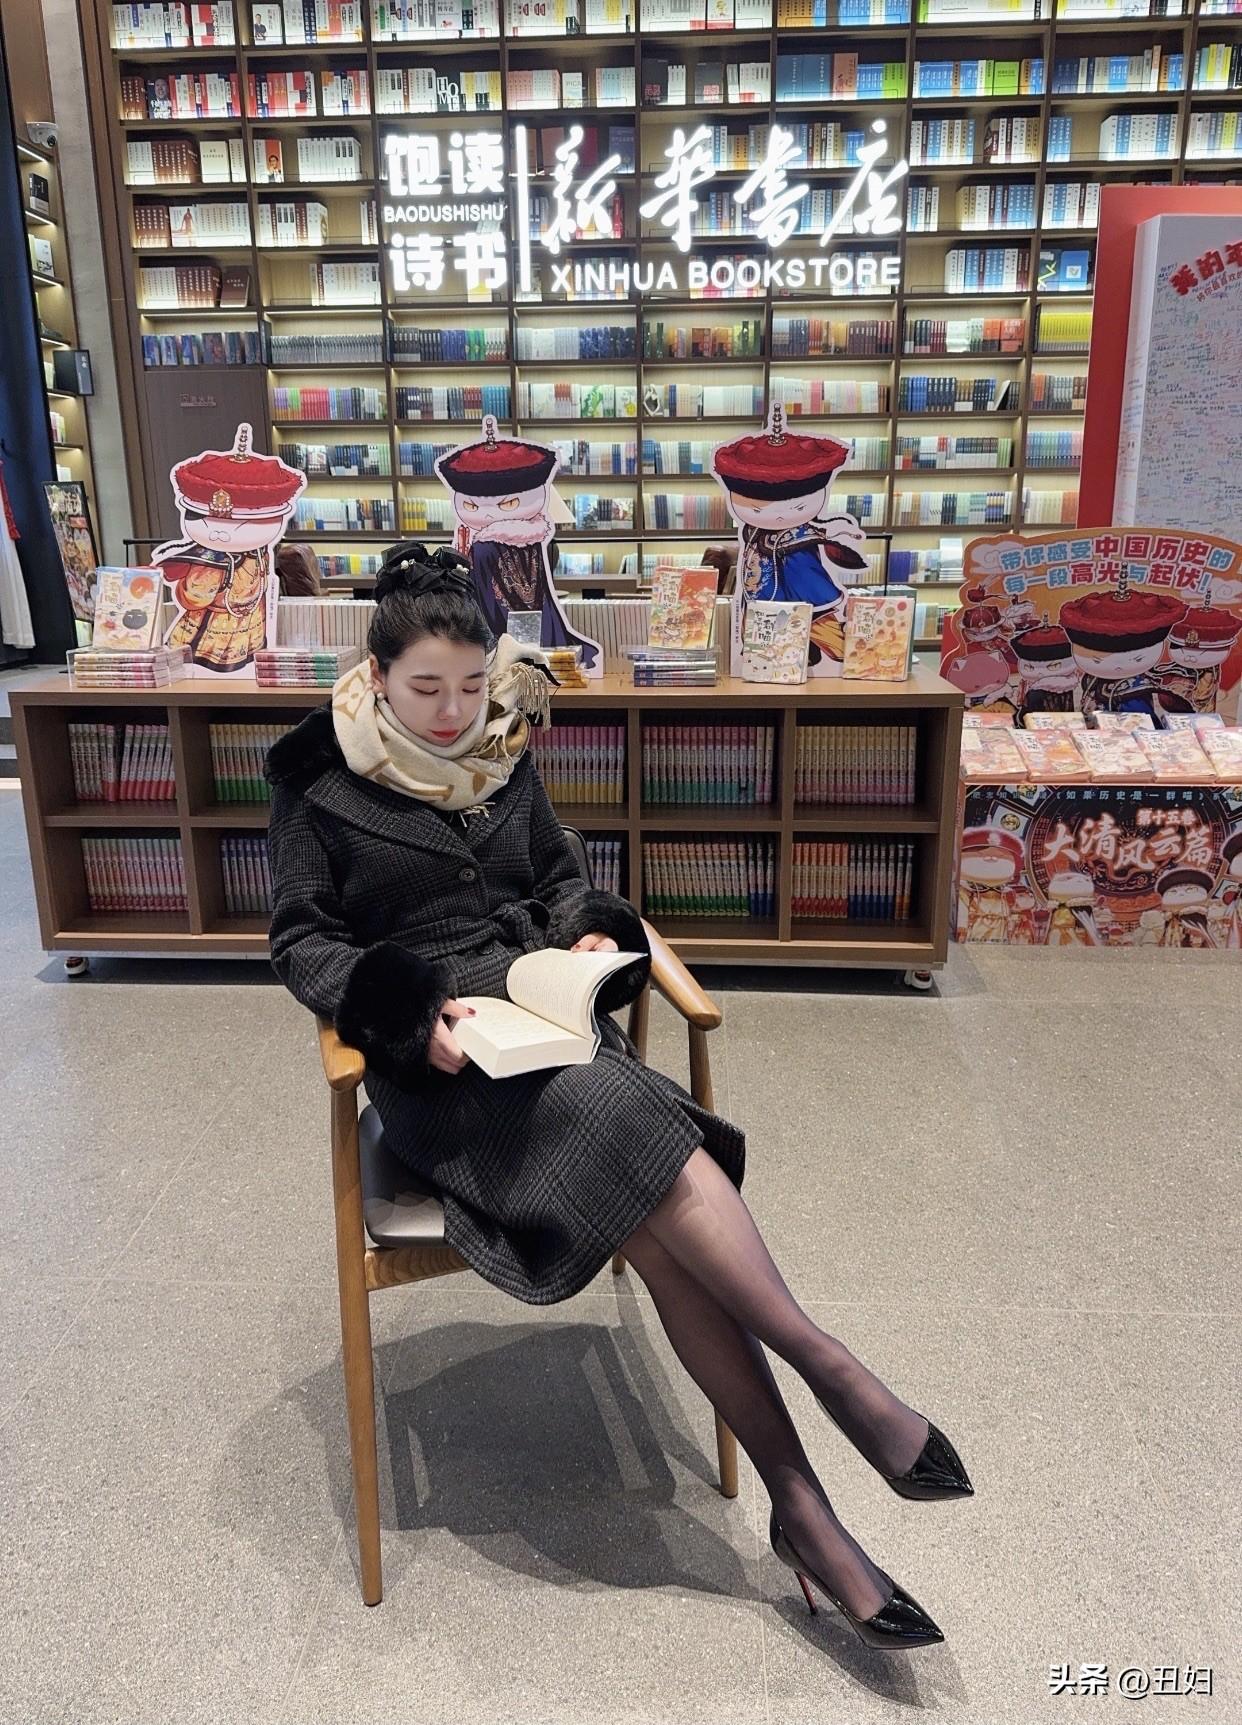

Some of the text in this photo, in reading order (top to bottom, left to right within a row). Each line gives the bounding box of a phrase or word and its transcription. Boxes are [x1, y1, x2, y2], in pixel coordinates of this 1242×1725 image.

[385, 133, 504, 196] 饱读
[384, 204, 504, 223] BAODUSHISHU
[389, 231, 508, 291] 诗书
[551, 257, 901, 292] XINHUA BOOKSTORE
[1000, 534, 1236, 572] 带你感受中国历史的
[1042, 811, 1212, 871] 大清风云篇
